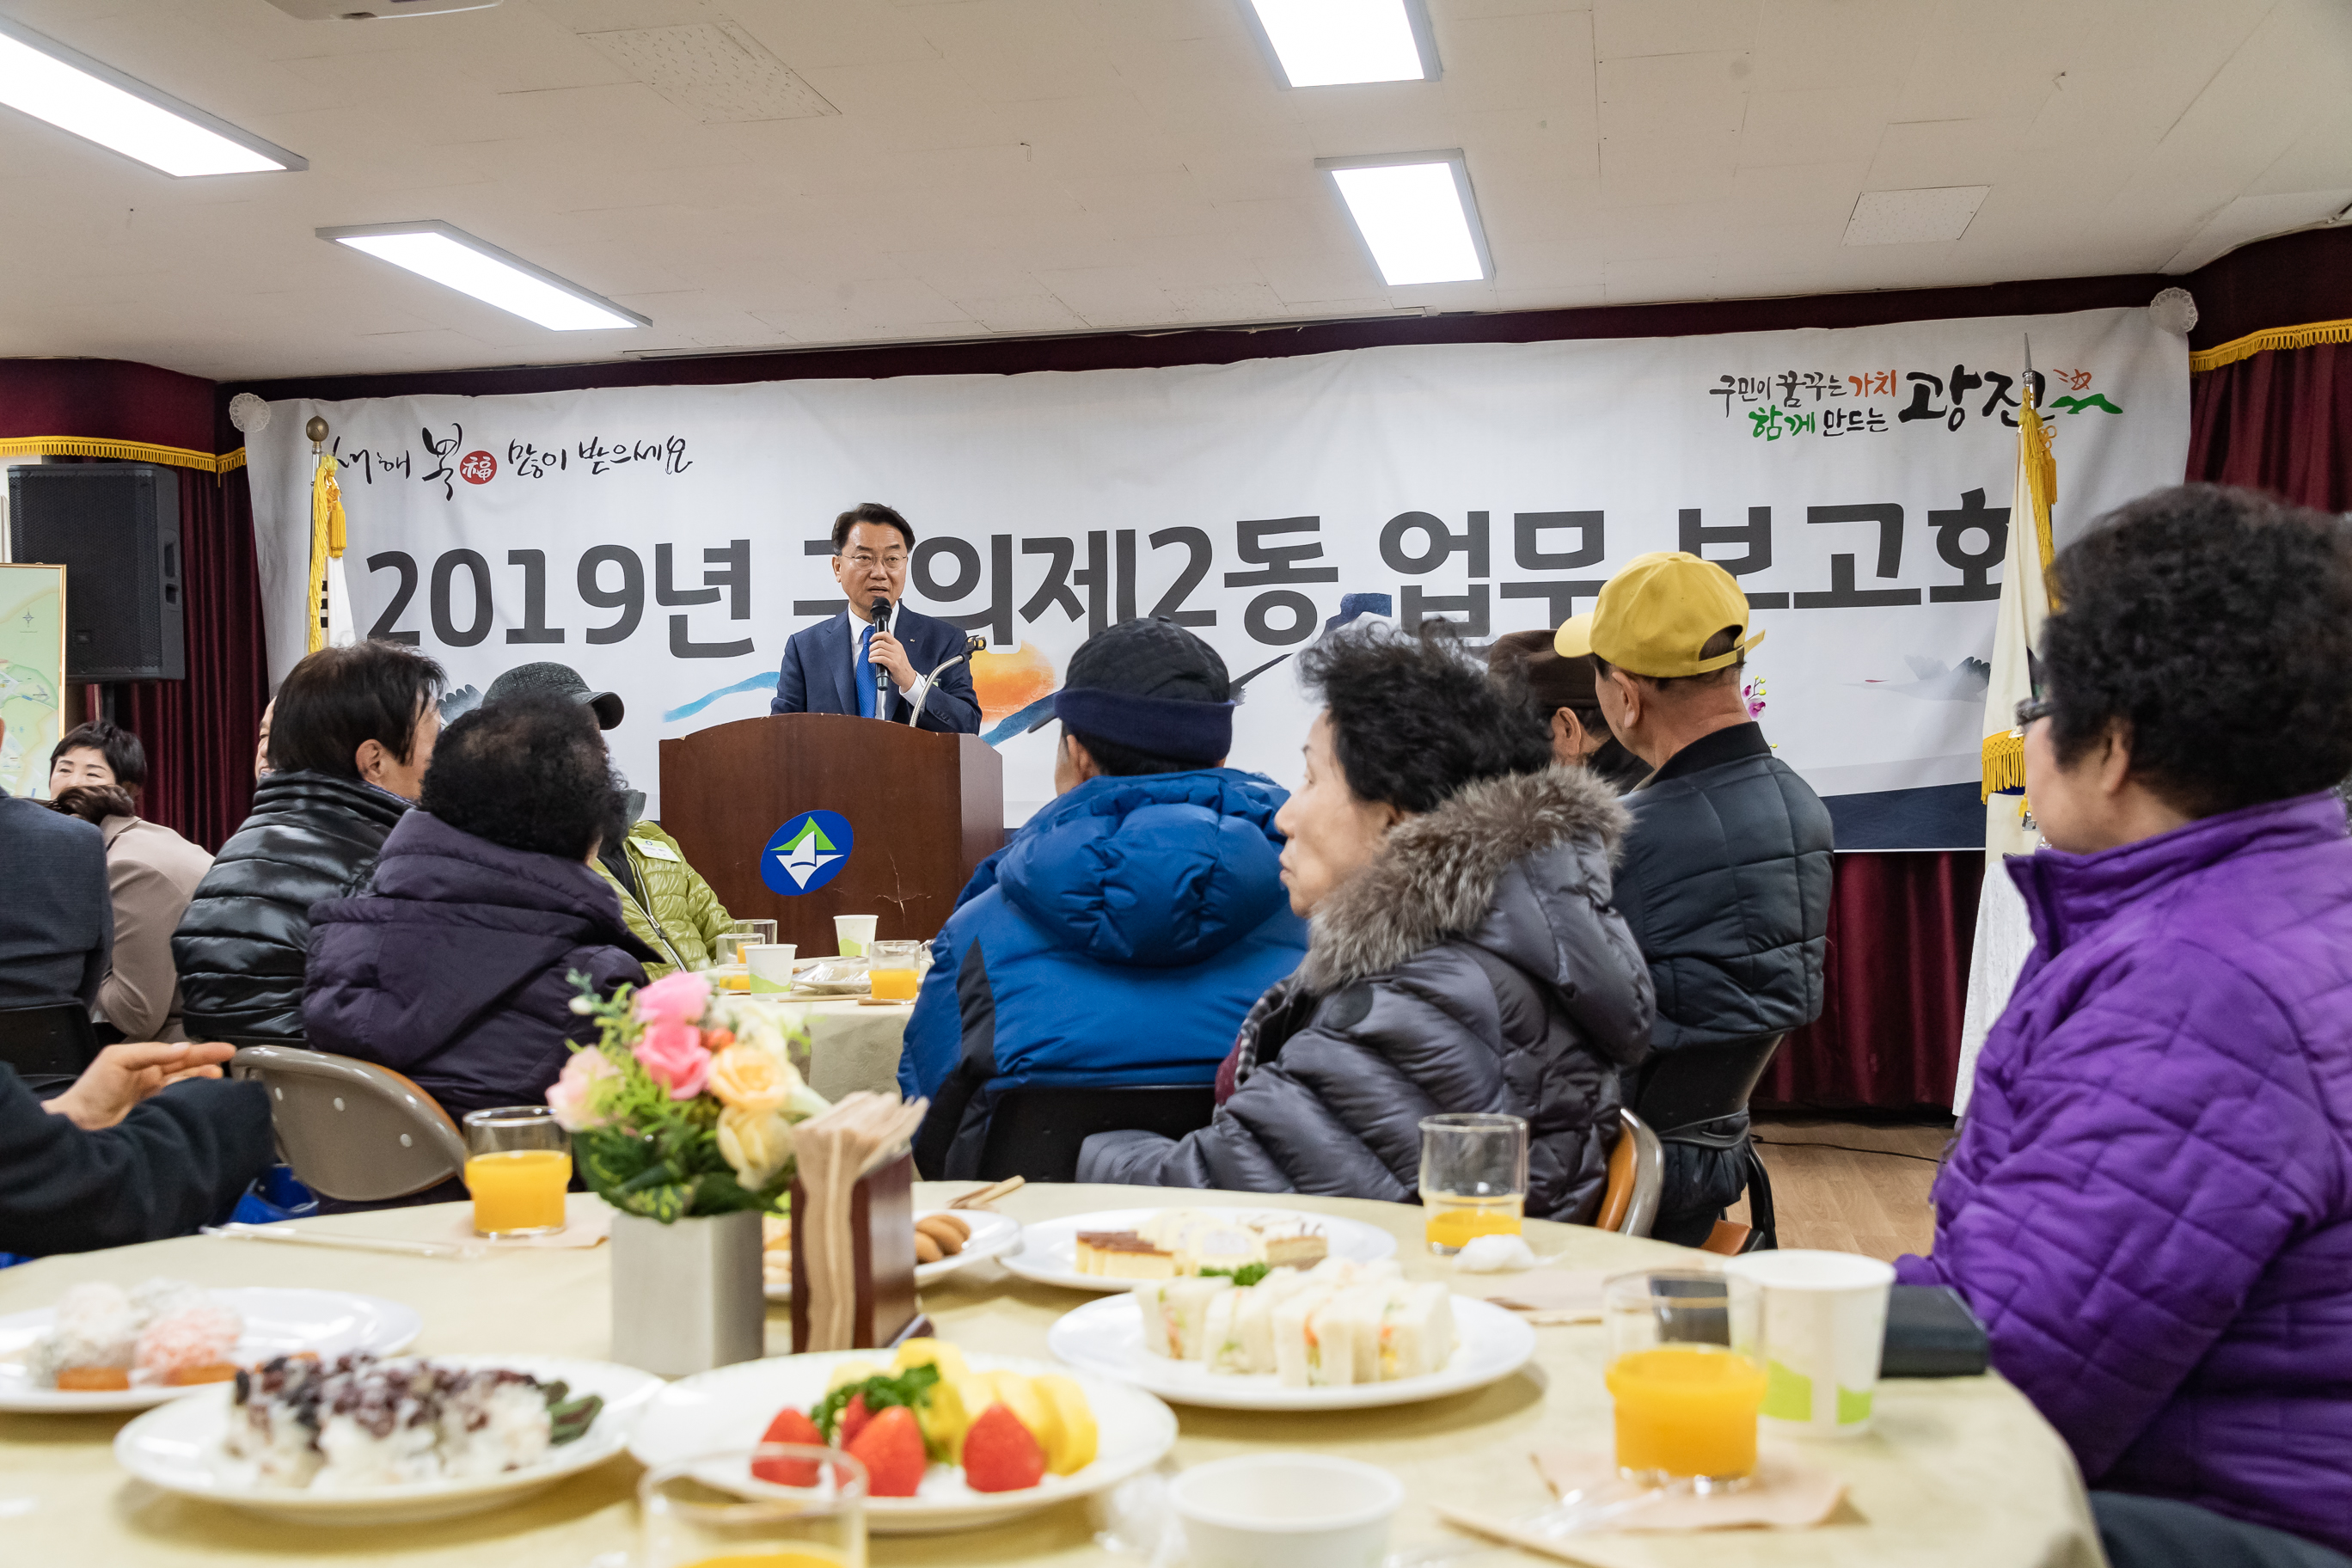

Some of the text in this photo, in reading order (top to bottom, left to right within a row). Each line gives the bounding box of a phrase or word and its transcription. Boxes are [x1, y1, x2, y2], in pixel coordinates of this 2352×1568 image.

[1709, 369, 1897, 419] 구민이 꿈꾸는 가치
[1748, 404, 1890, 442] 함께 만드는
[1897, 364, 2056, 432] 광진
[332, 422, 694, 502] 새해 복 福 많이 받으세요
[366, 538, 756, 659] 2019년
[1379, 510, 1606, 639] 업무
